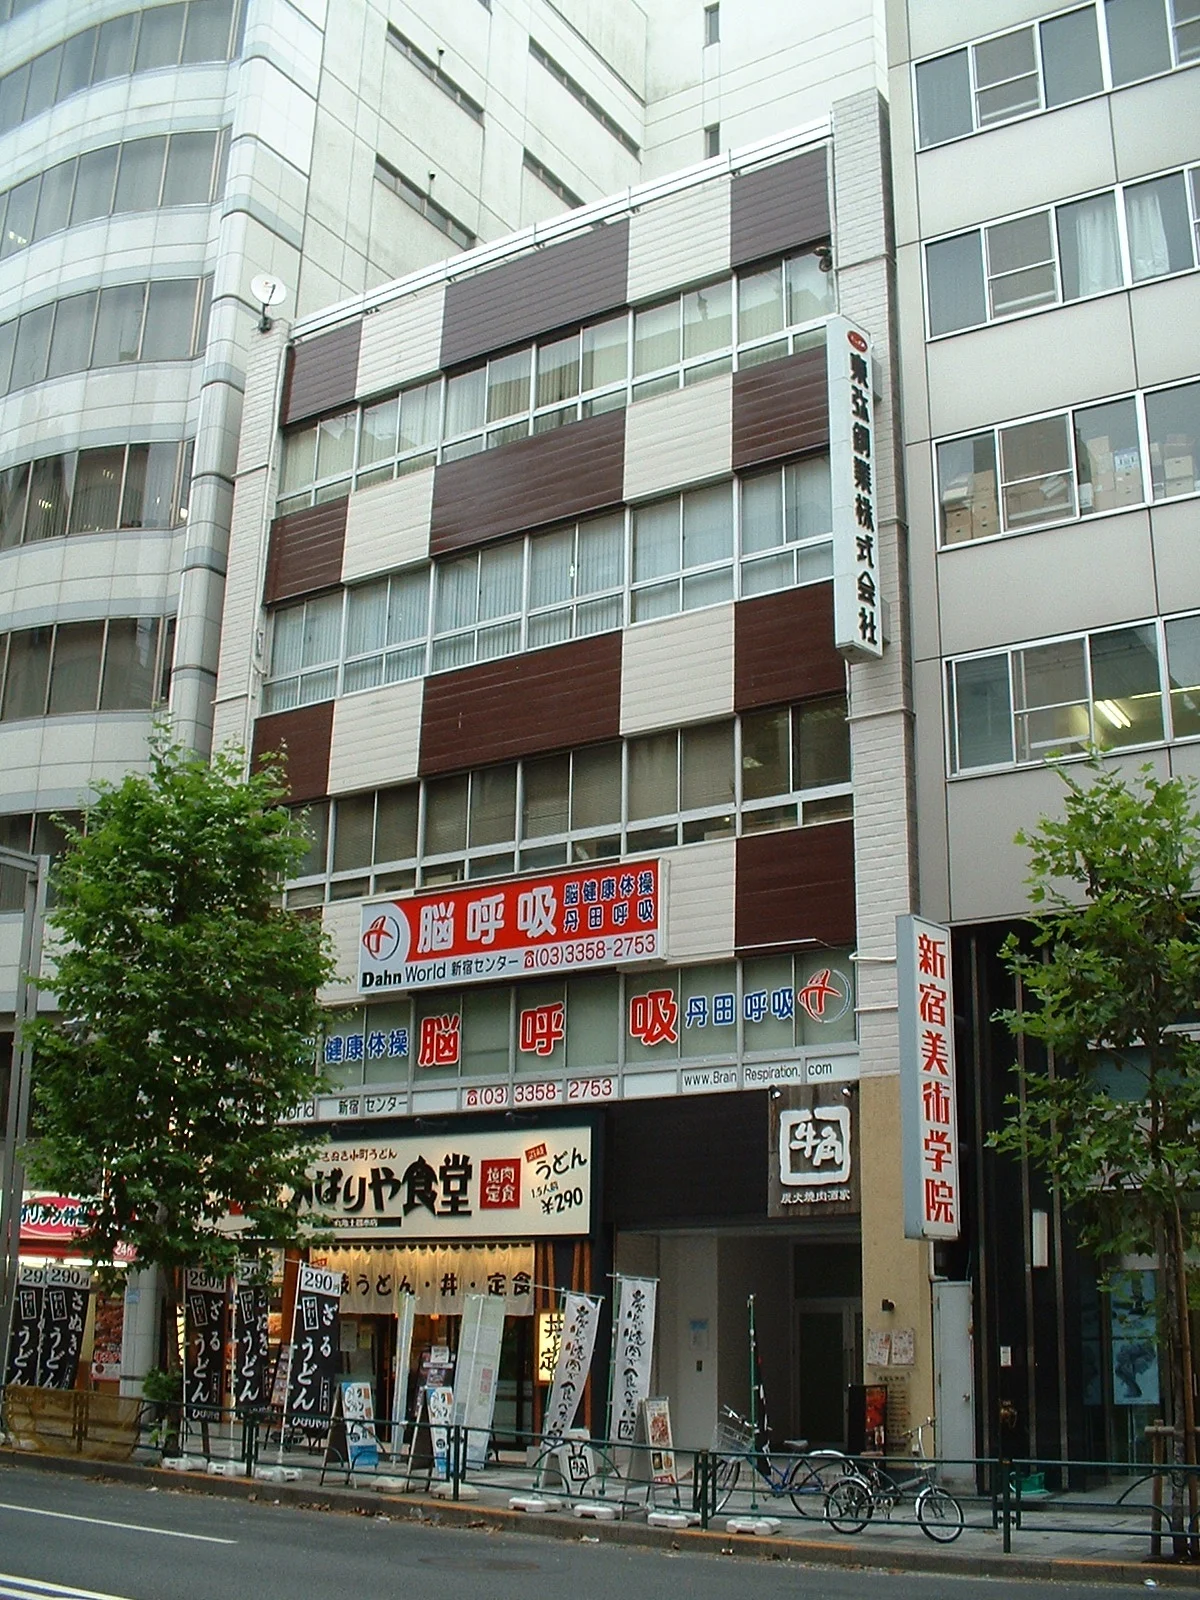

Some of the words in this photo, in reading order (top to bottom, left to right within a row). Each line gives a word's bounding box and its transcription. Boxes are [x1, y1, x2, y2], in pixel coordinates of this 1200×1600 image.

[418, 886, 556, 953] 脳呼吸
[563, 870, 654, 906] 脳健康体操
[563, 899, 654, 933] 丹田呼吸
[361, 971, 401, 988] Dahn
[405, 961, 446, 983] World
[451, 956, 518, 977] 新宿センター
[535, 933, 656, 968] (03)3358-2753
[293, 1029, 409, 1065] 健康体操
[417, 1012, 460, 1067] 脳
[519, 1001, 564, 1056] 呼
[629, 988, 677, 1046] 吸
[685, 986, 794, 1029] 丹田呼吸
[278, 1100, 315, 1119] orld
[919, 934, 954, 1223] 新宿美術学院
[298, 1152, 472, 1217] ばりや食堂
[486, 1184, 515, 1203] 定食
[535, 1147, 587, 1180] うどん
[191, 1333, 210, 1402] うどん
[239, 1331, 260, 1401] うどん
[293, 1336, 319, 1411] うどん
